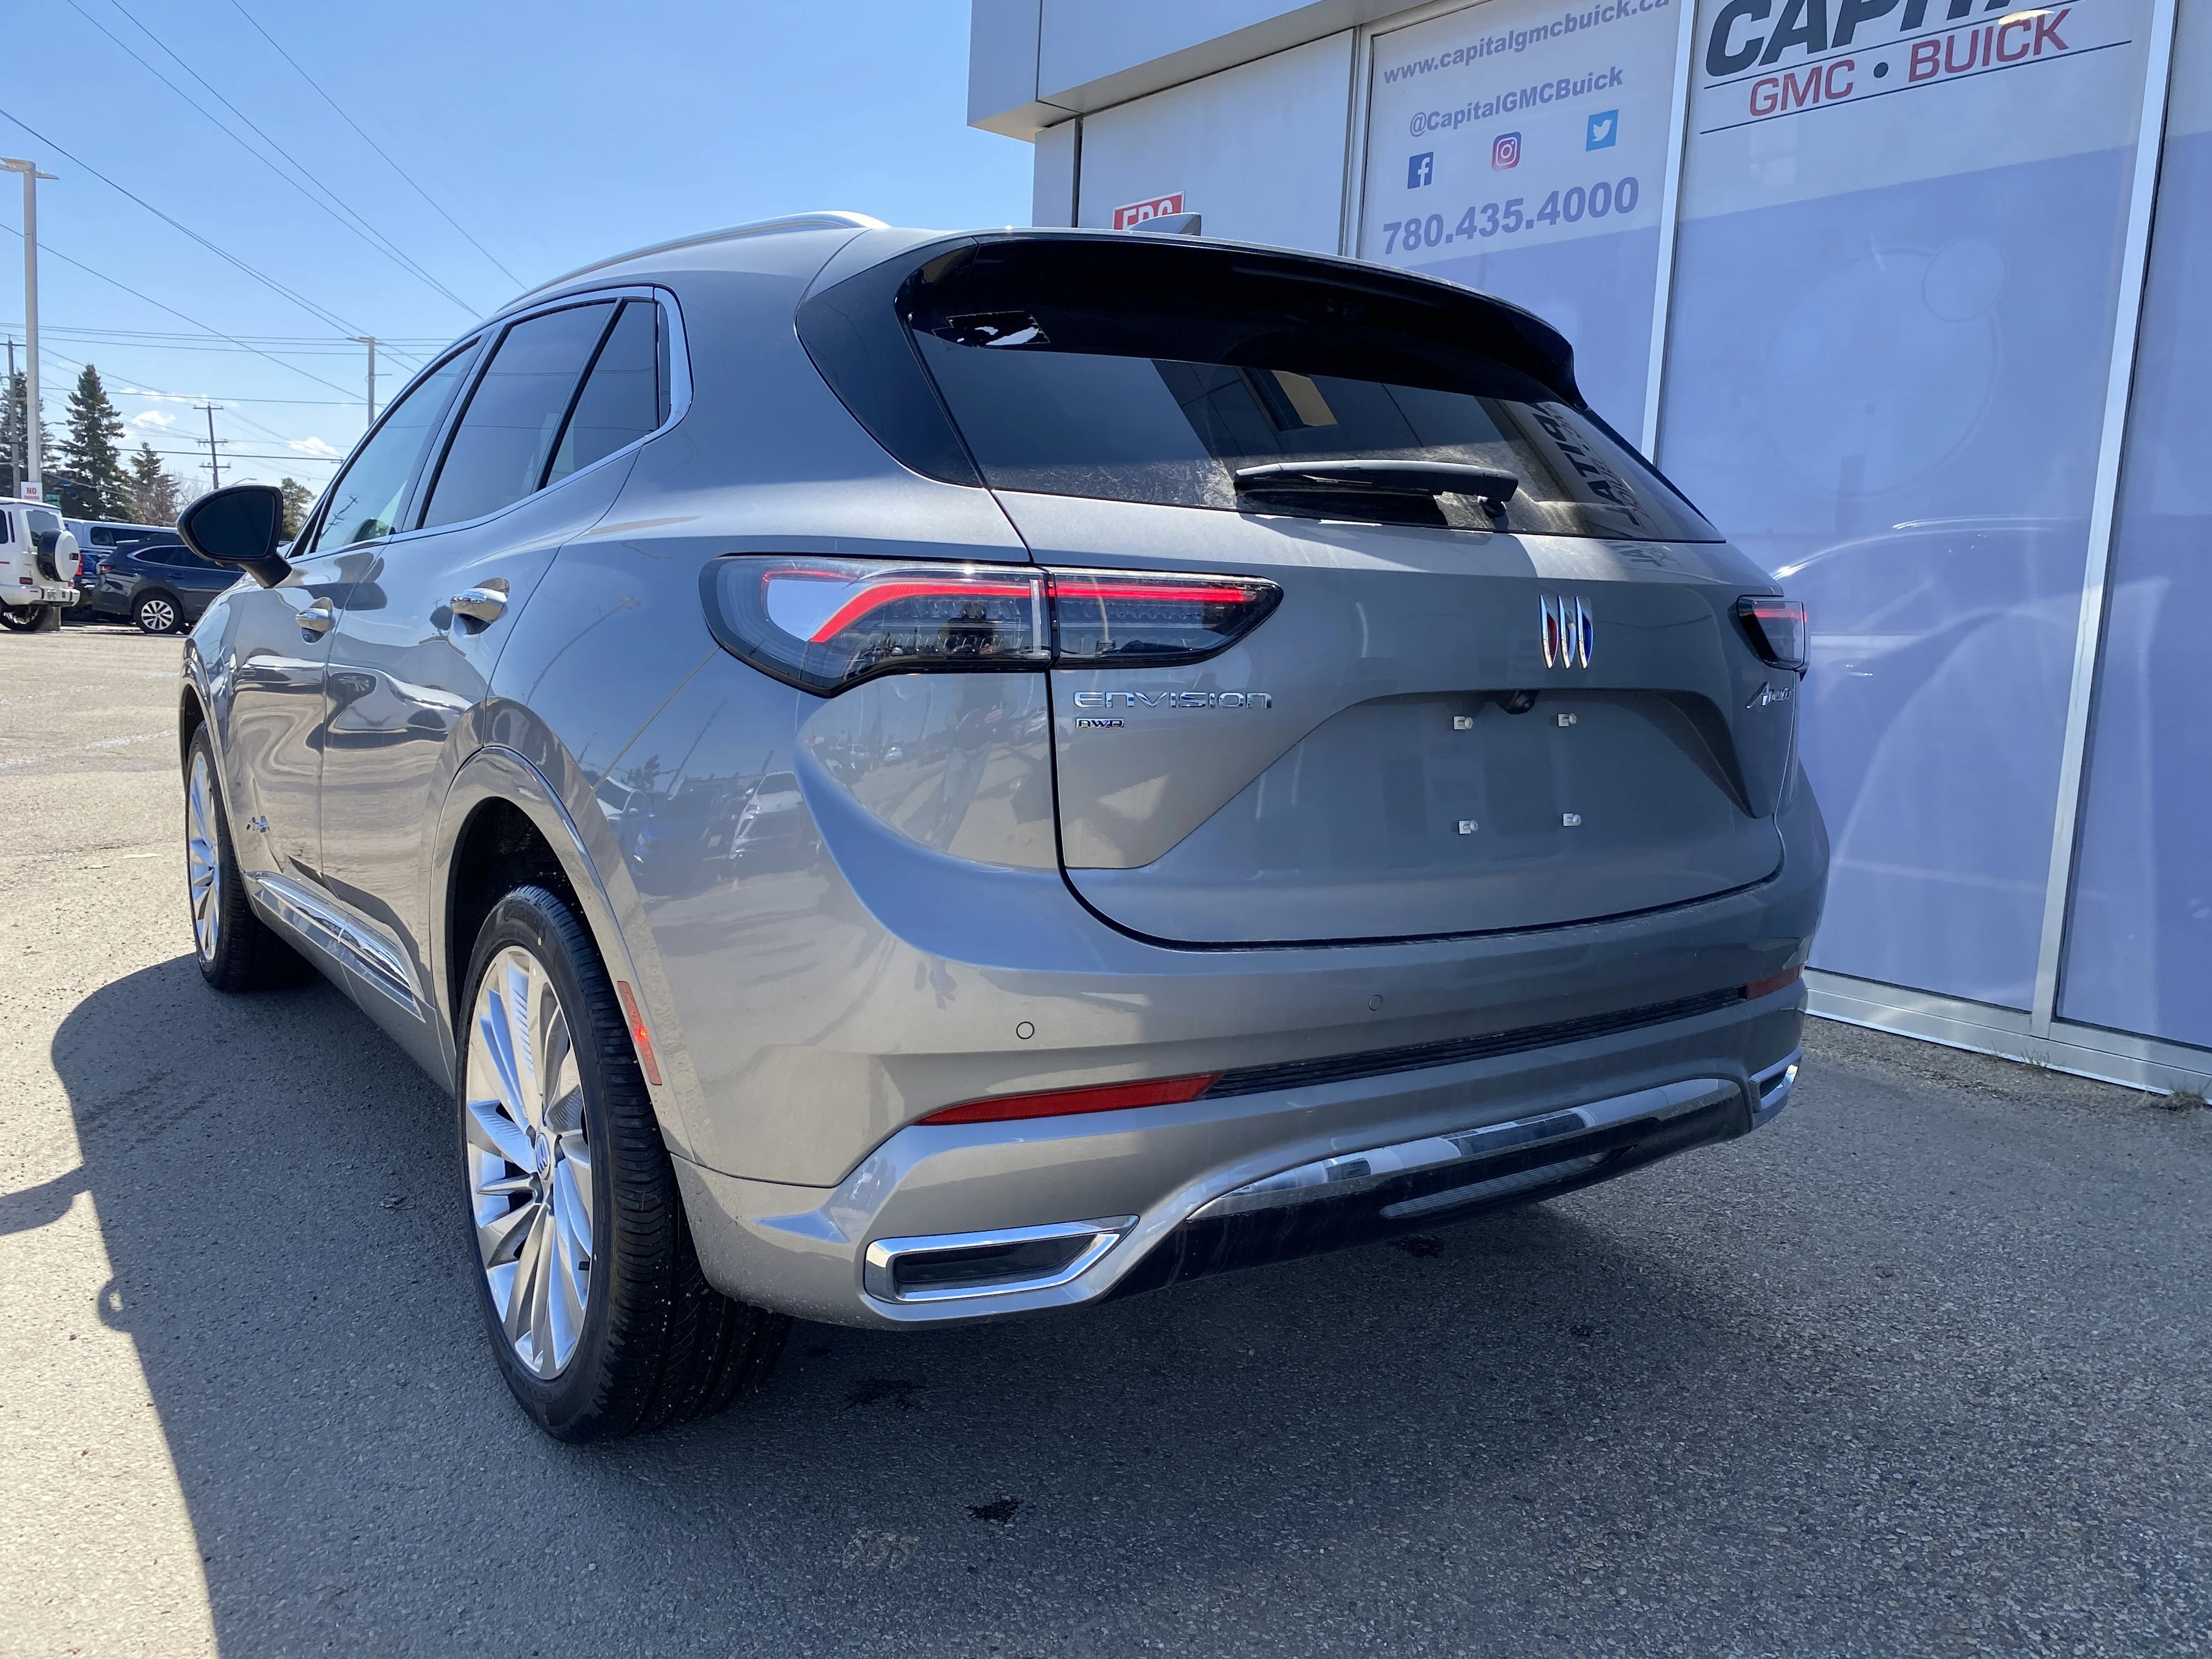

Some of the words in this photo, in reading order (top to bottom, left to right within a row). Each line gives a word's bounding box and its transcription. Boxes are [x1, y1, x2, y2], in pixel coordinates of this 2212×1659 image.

[1750, 59, 1855, 116] GMC
[1908, 8, 2072, 82] BUICK
[1410, 66, 1623, 137] @CapitalGMCBuick
[1383, 177, 1639, 255] 780.435.4000
[1077, 719, 1124, 728] AWD
